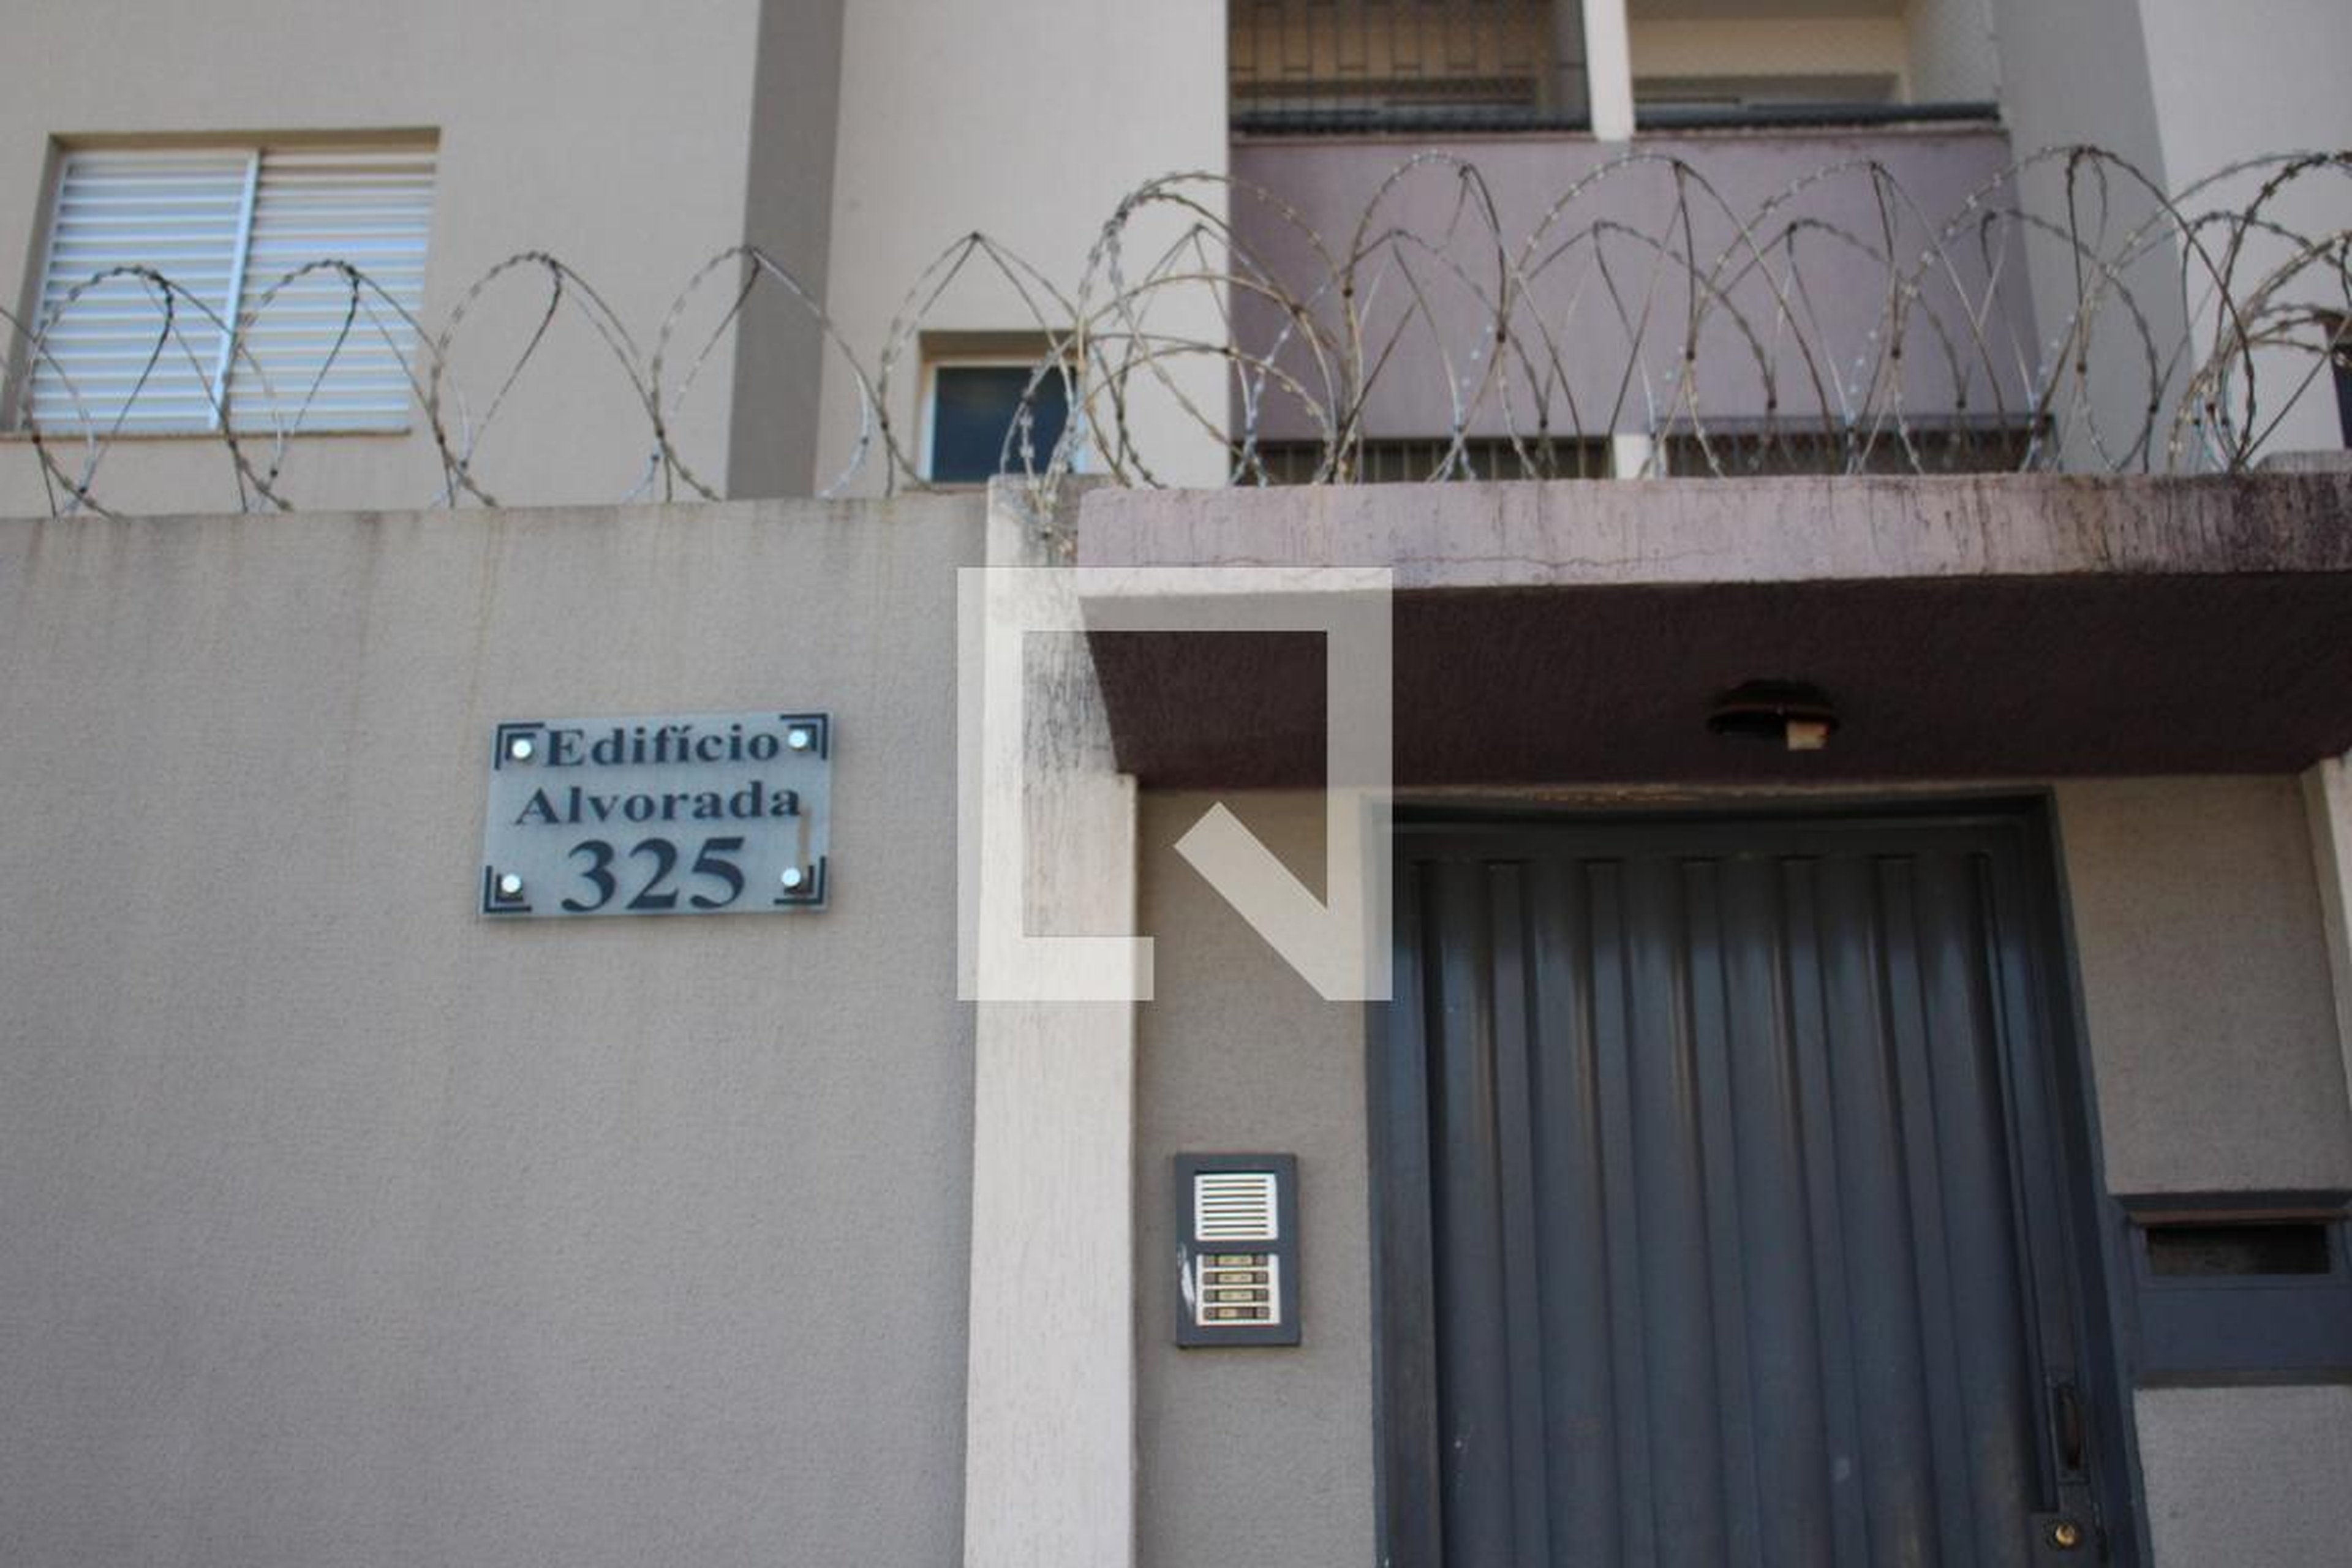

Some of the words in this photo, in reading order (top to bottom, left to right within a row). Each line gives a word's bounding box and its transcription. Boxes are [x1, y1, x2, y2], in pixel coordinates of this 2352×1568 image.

[544, 725, 779, 767] Edifício
[514, 781, 801, 825] Alvorada
[561, 837, 745, 912] 325
